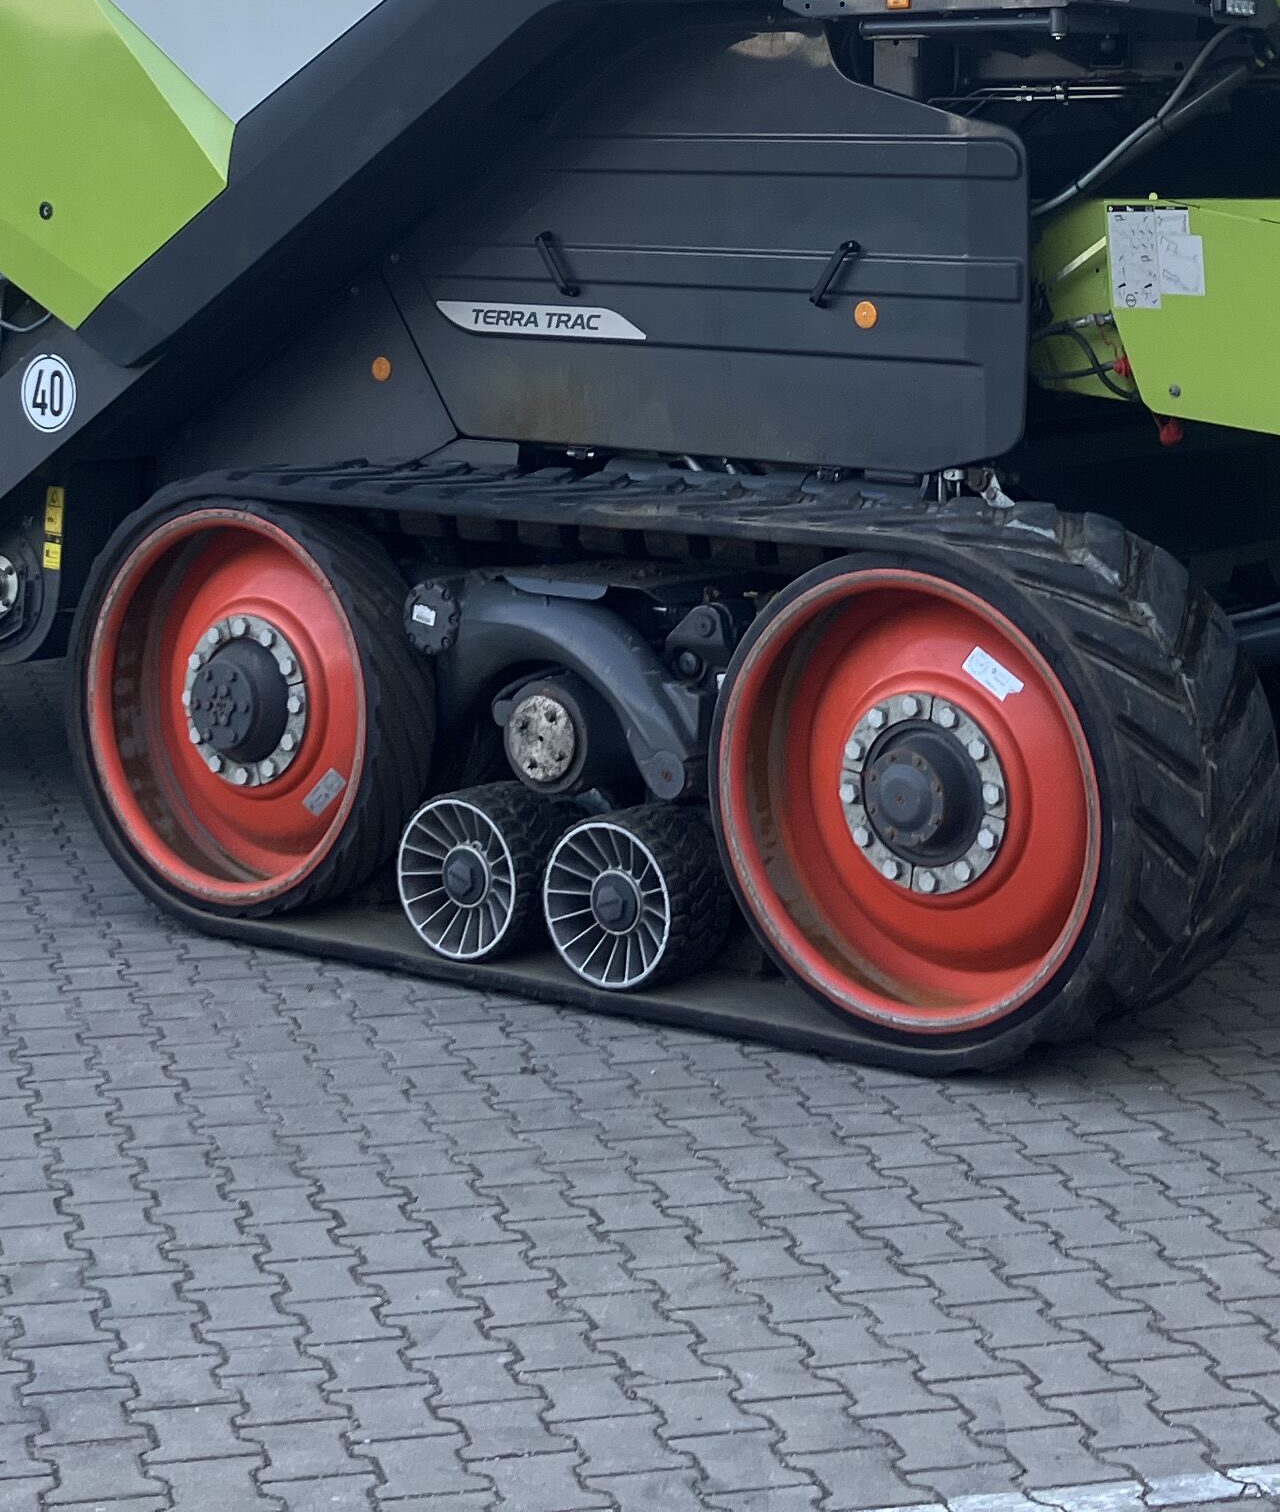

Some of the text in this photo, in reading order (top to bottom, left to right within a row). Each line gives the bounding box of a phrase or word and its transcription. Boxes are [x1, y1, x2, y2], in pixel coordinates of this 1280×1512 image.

[472, 308, 601, 331] TERRA TRAC
[32, 369, 64, 417] 40
